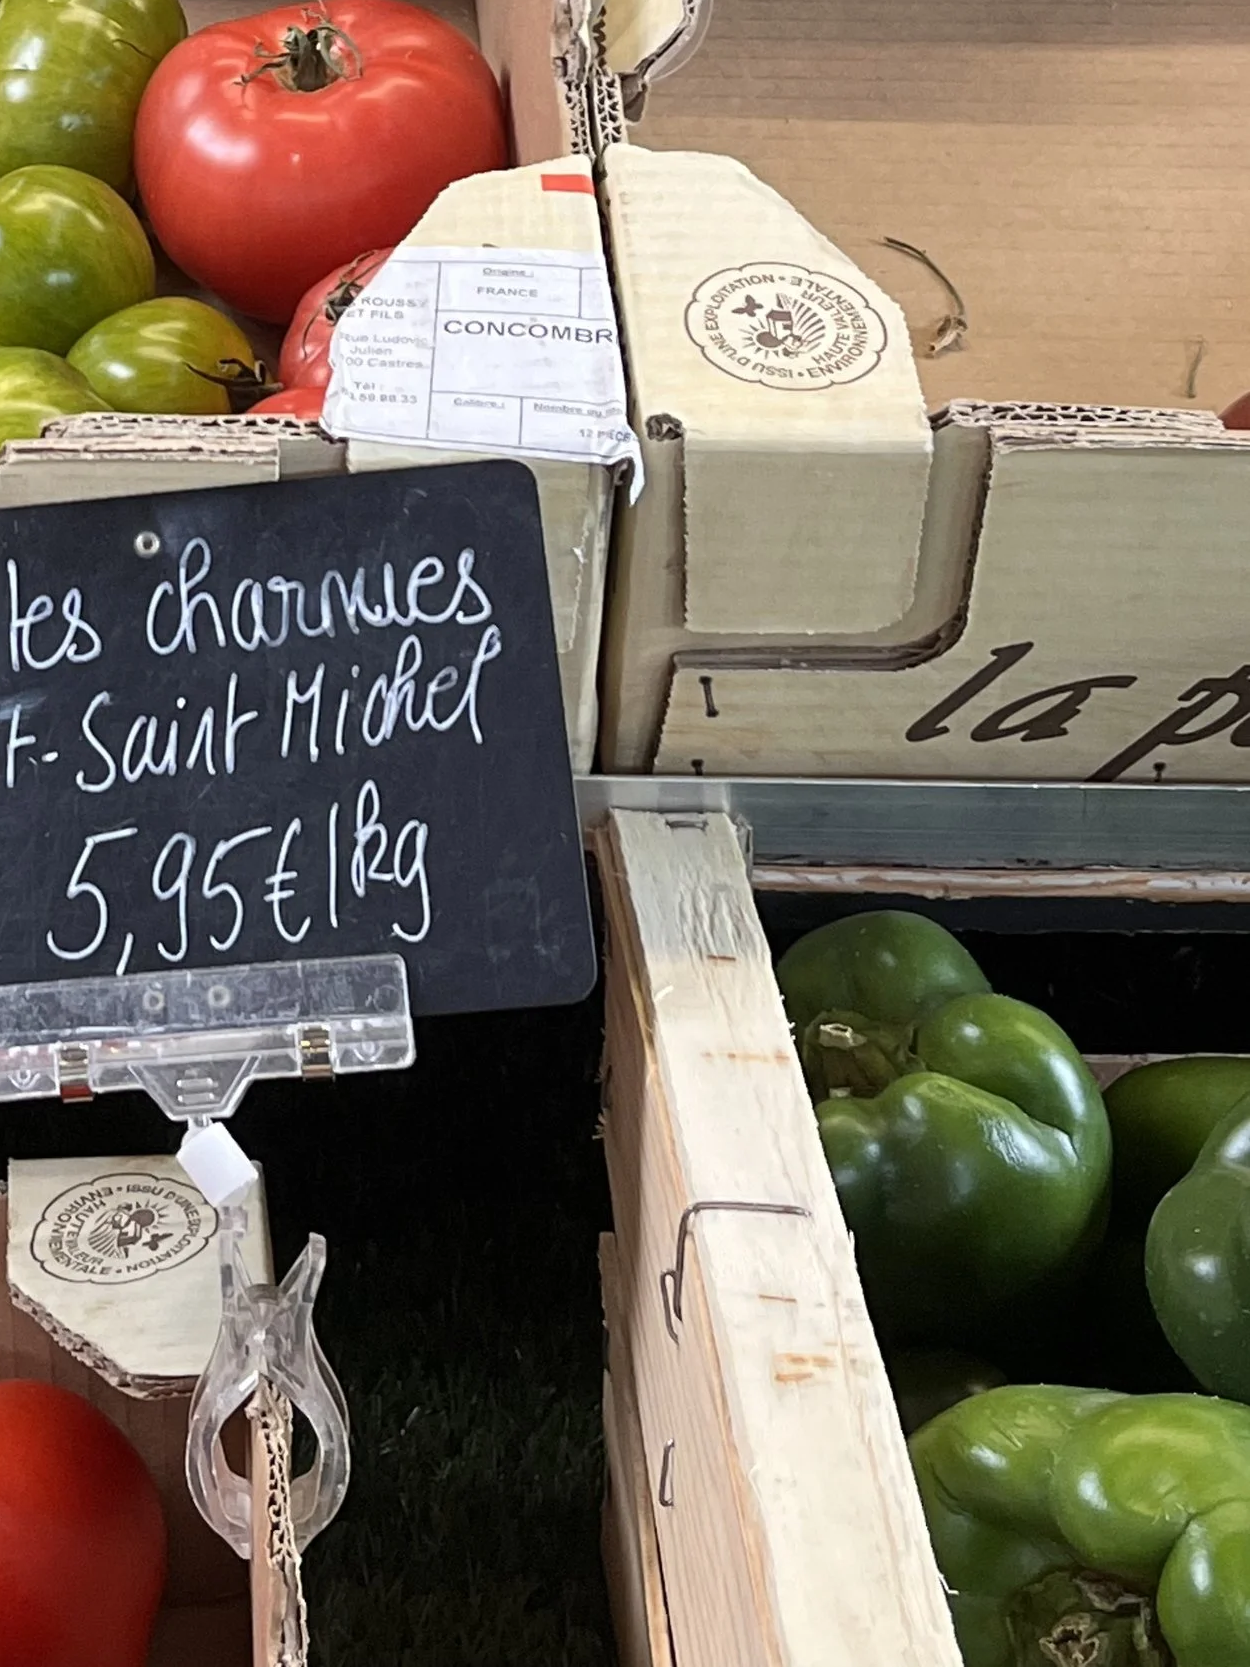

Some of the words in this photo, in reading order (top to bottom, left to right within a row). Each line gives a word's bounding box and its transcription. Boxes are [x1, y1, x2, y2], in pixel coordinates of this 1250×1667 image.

[444, 320, 617, 344] CONCOMBR
[477, 286, 538, 298] FRANCE
[811, 334, 851, 365] HAUTE
[146, 537, 492, 655] charnues
[282, 625, 501, 764] Michel
[905, 641, 1138, 742] la
[47, 780, 432, 977] 5,95€/kg
